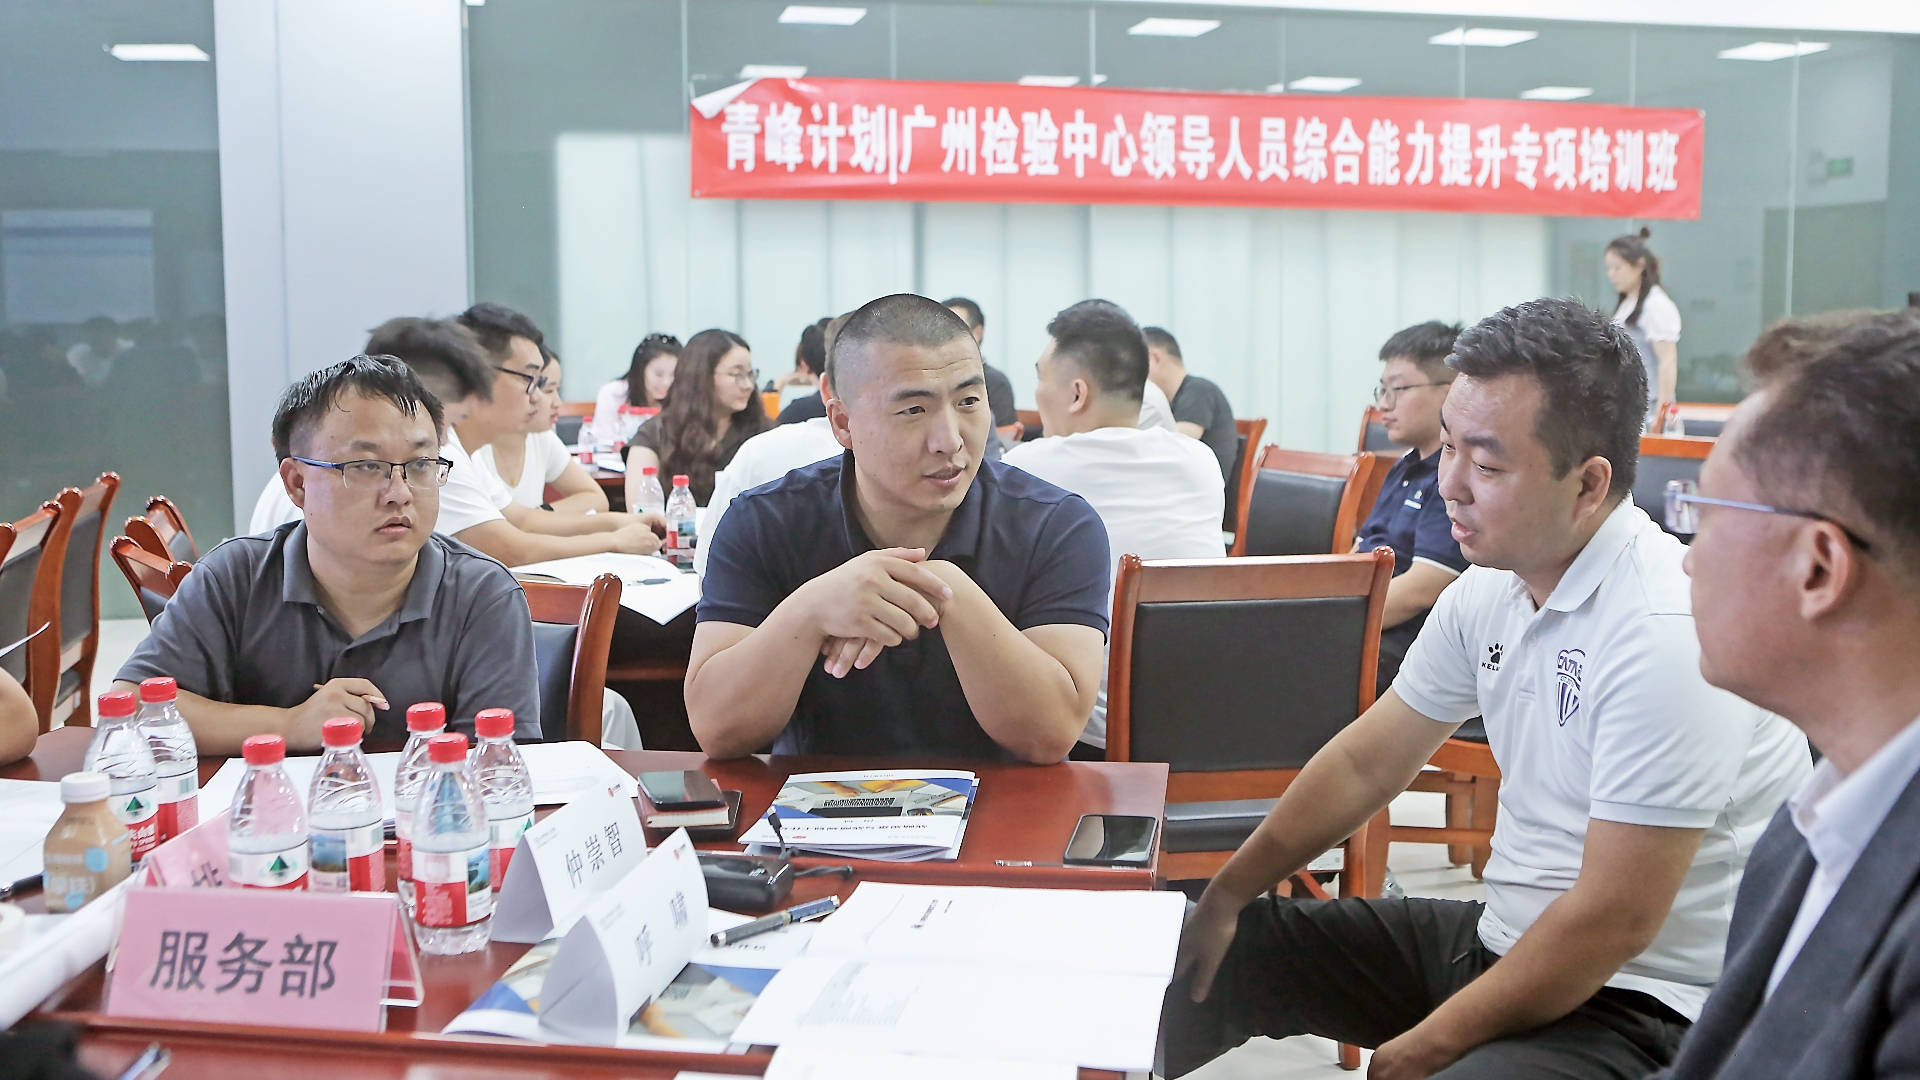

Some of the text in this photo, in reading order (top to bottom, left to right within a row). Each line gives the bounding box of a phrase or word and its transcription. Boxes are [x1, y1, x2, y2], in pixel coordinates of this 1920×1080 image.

[721, 100, 1680, 193] 青峰计划|广州检验中心领导人员综合能力提升专项培训班
[565, 822, 622, 889] 仲崇智
[149, 929, 339, 999] 服务部
